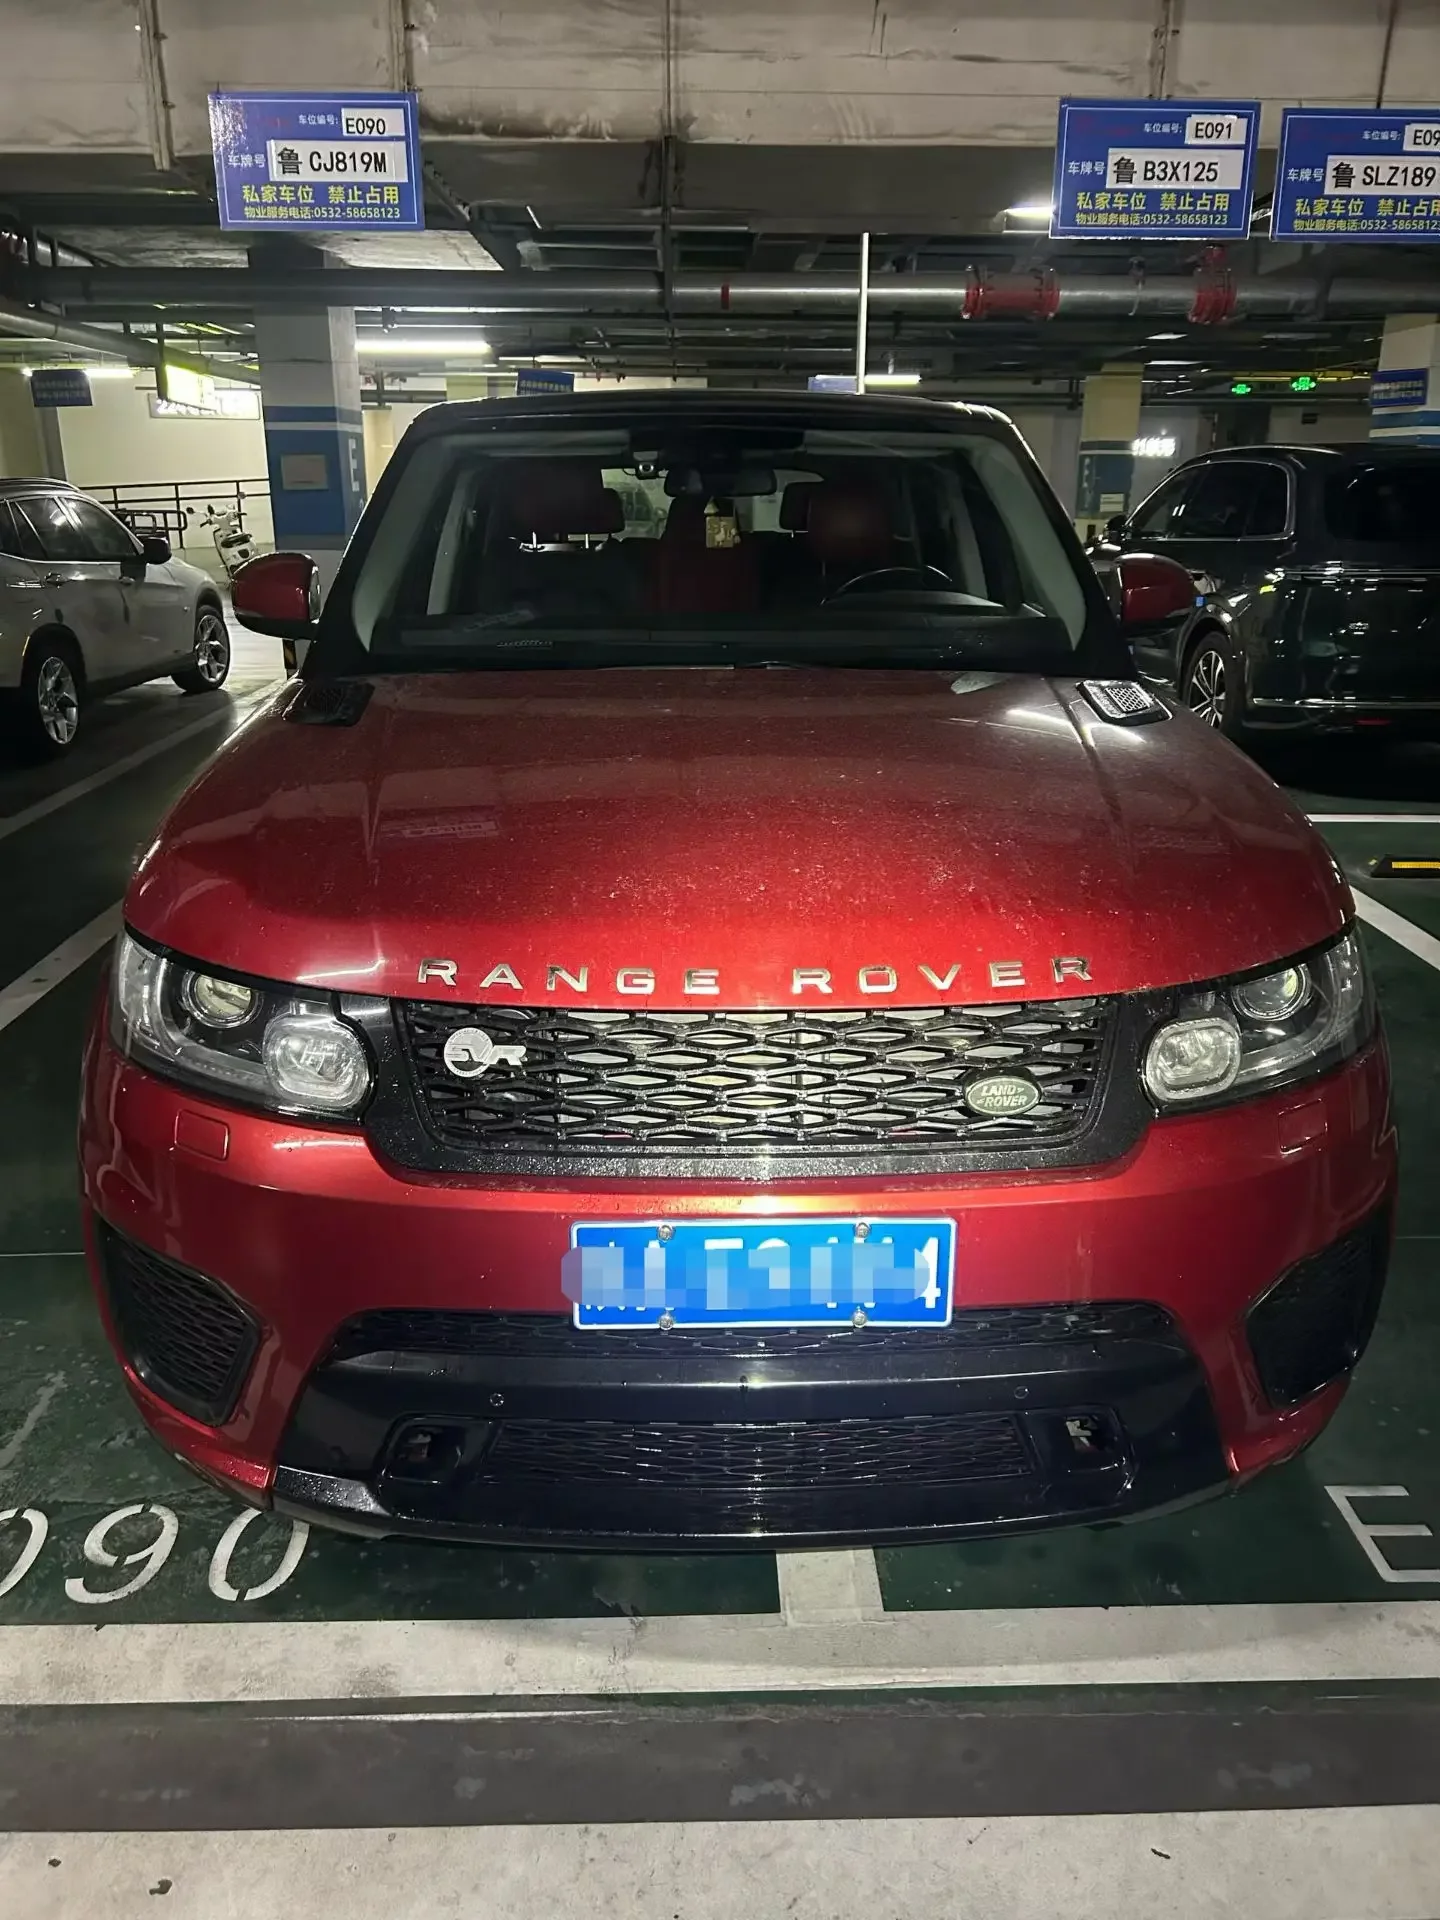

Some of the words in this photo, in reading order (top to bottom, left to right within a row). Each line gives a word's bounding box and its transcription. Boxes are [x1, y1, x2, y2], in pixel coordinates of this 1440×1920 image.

[345, 118, 386, 135] E090
[1194, 122, 1233, 139] E091
[228, 154, 266, 168] 车牌号
[277, 147, 303, 175] 鲁
[309, 151, 387, 173] CJ819M
[1068, 160, 1106, 175] 车牌号
[1113, 156, 1137, 184] 鲁
[1143, 160, 1219, 182] B3X125
[1287, 168, 1324, 182] 车牌号
[1332, 161, 1356, 189] 鲁
[1362, 165, 1437, 187] SLZ189
[242, 184, 315, 204] 私家车位
[328, 184, 400, 205] 禁止占用
[1076, 192, 1147, 210] 私家车位
[1160, 192, 1230, 211] 禁止占用
[1295, 198, 1365, 216] 私家车位
[417, 957, 721, 996] RANGE
[790, 955, 1094, 994] ROVER
[981, 1085, 1017, 1096] LAND
[983, 1095, 1028, 1107] ROVER
[1324, 1485, 1440, 1582] E
